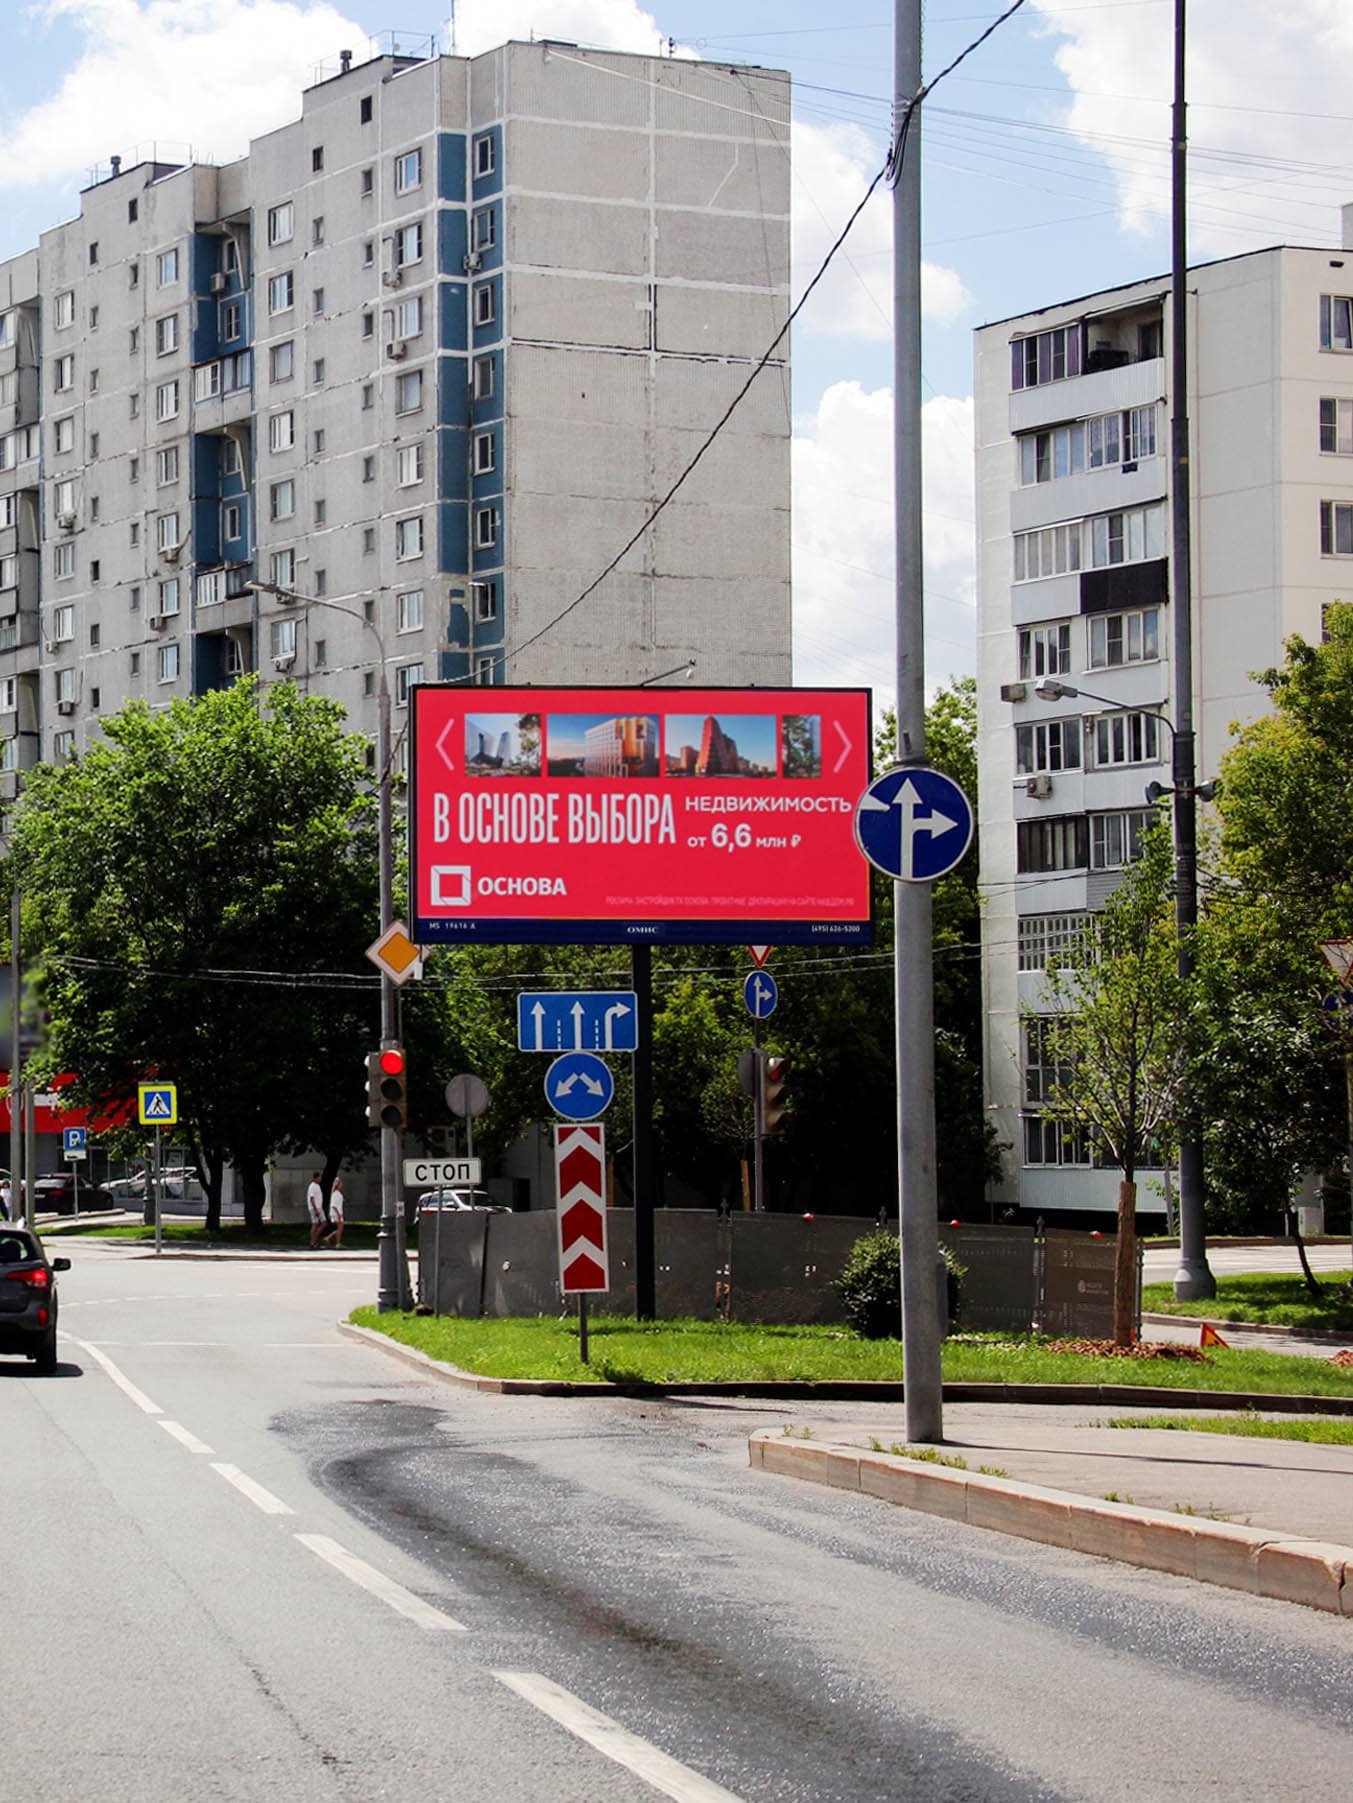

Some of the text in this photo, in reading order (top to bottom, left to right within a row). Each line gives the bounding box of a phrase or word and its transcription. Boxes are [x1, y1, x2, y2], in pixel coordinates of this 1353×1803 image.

[685, 796, 852, 813] НЕДВИЖИМОСТЬ
[434, 792, 676, 844] В ОСНОВЕ ВЫБОРА
[687, 836, 706, 847] от
[711, 823, 752, 853] 6,6
[756, 837, 786, 847] млн
[478, 877, 567, 896] ОСНОВА
[415, 1164, 470, 1181] СТОП
